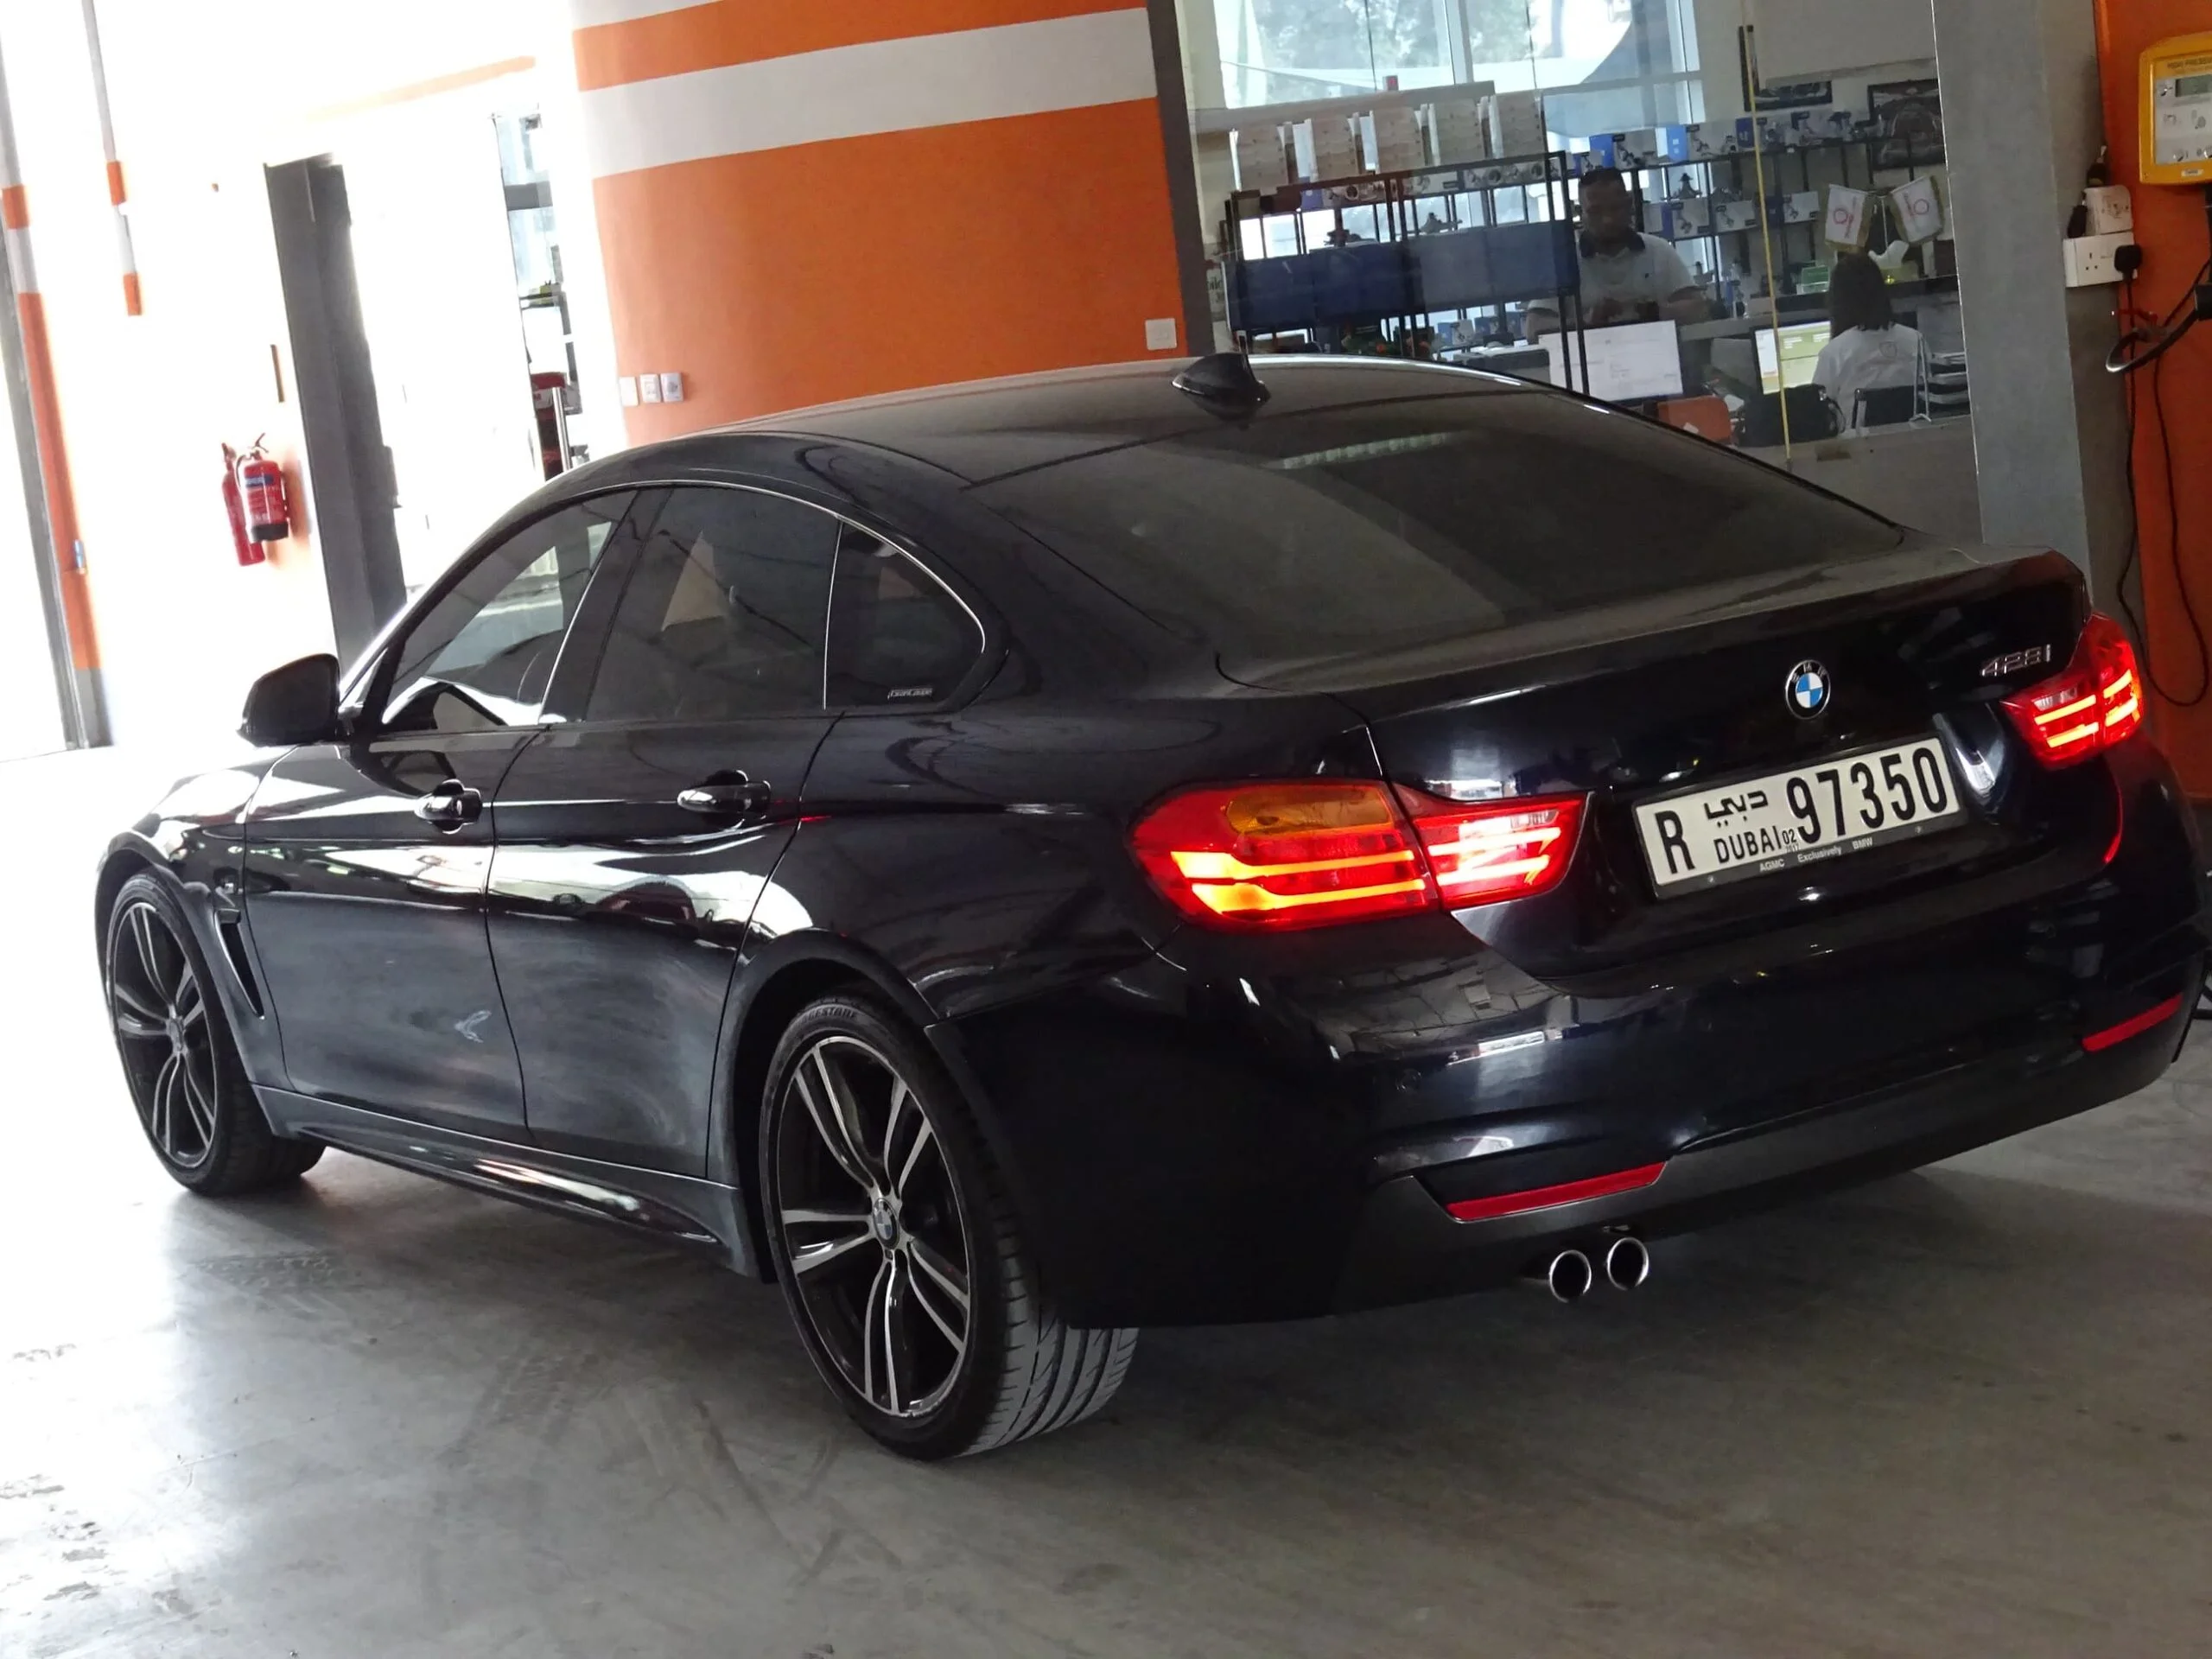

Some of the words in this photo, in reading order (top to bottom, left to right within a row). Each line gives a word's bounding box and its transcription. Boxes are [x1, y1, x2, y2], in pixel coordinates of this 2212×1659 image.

[1981, 644, 2051, 677] 428i
[1704, 791, 1769, 828] دبي
[1786, 747, 1948, 844] 97350
[1655, 810, 1695, 874] R
[1713, 826, 1782, 864] DUBAI
[1782, 829, 1796, 845] 02
[1759, 859, 1785, 873] AGMC
[1797, 846, 1842, 863] Exclusively
[1852, 837, 1873, 851] BMW
